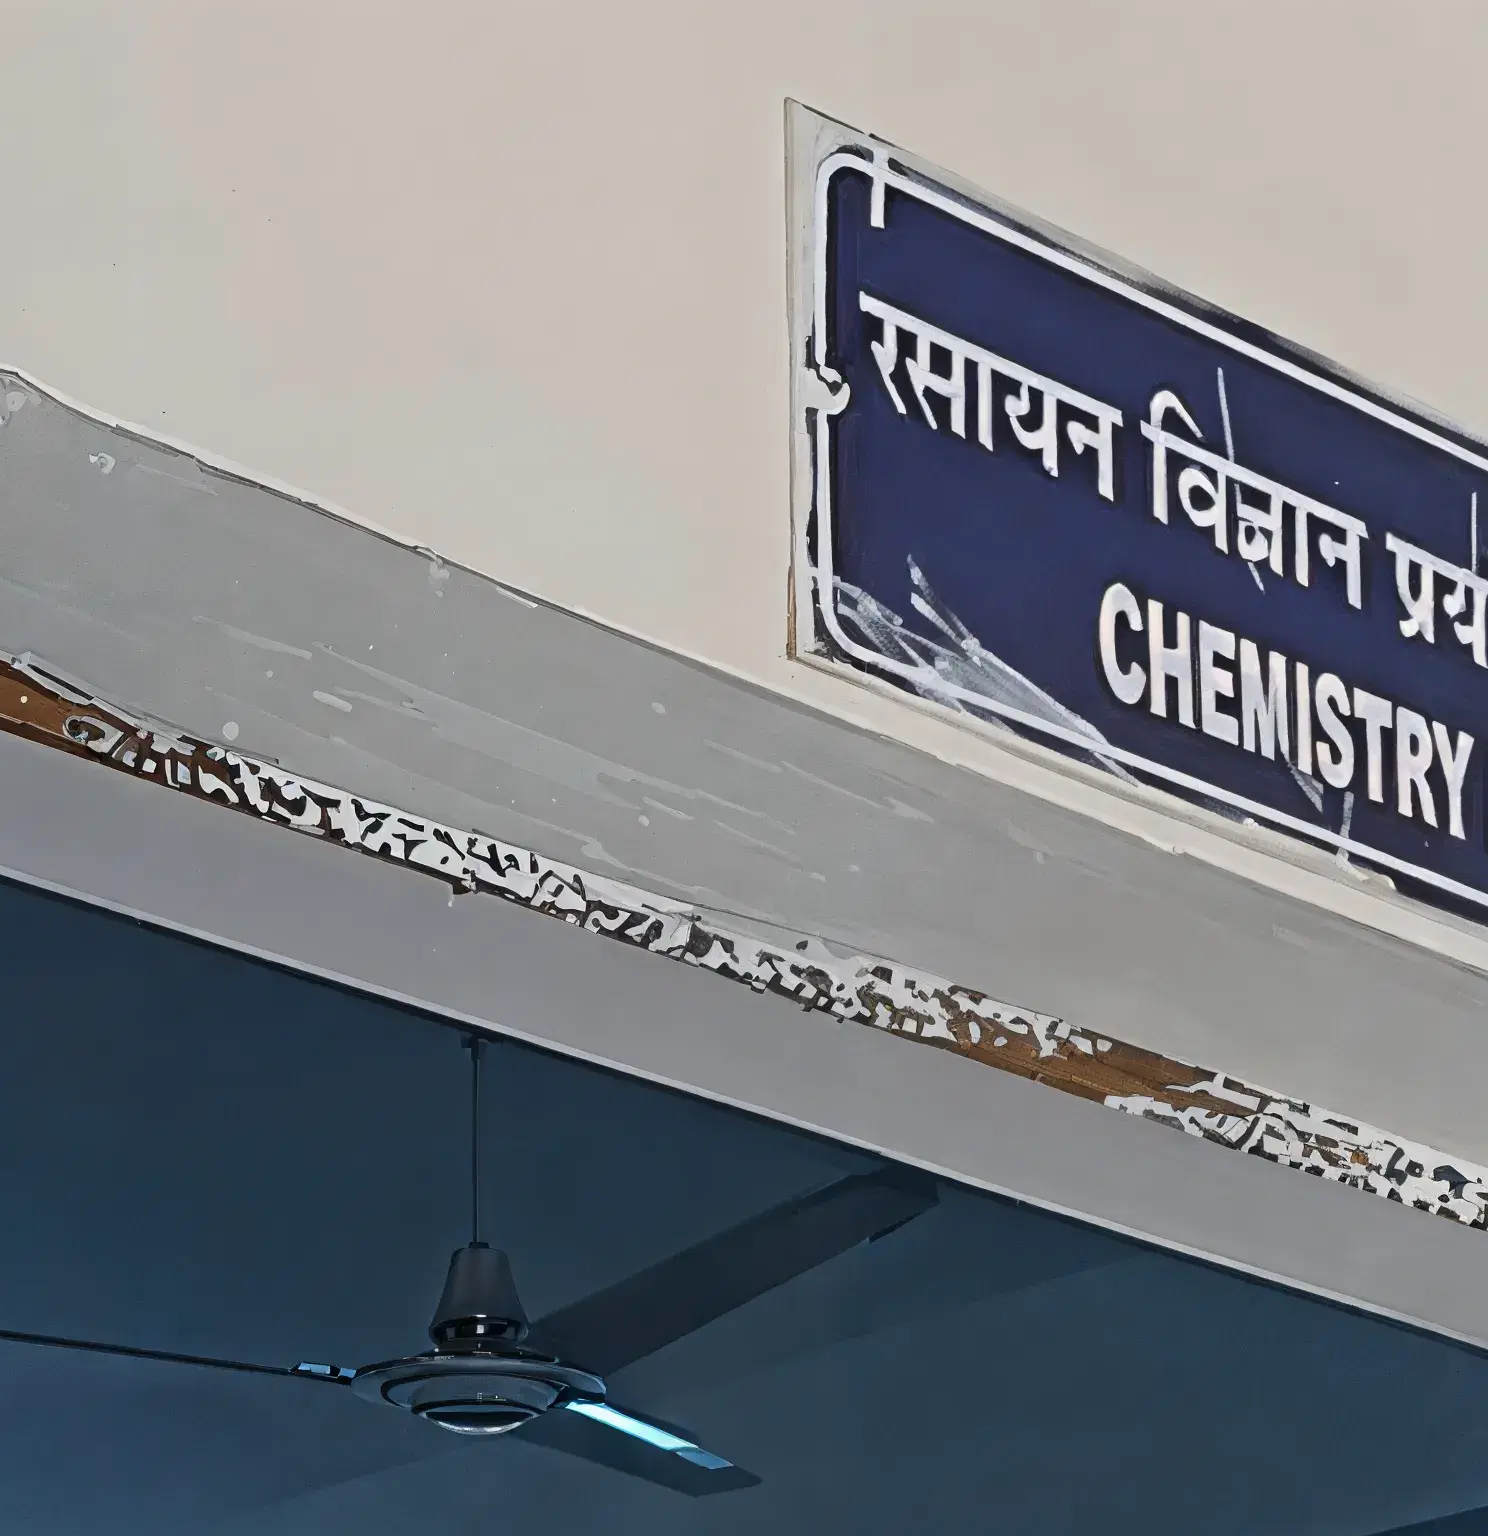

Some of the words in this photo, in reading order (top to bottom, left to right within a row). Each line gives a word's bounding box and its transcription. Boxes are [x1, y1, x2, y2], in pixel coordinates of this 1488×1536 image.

[858, 290, 1124, 502] रसायन
[1140, 388, 1369, 610] विज्ञान
[1097, 583, 1476, 841] CHEMISTRY
